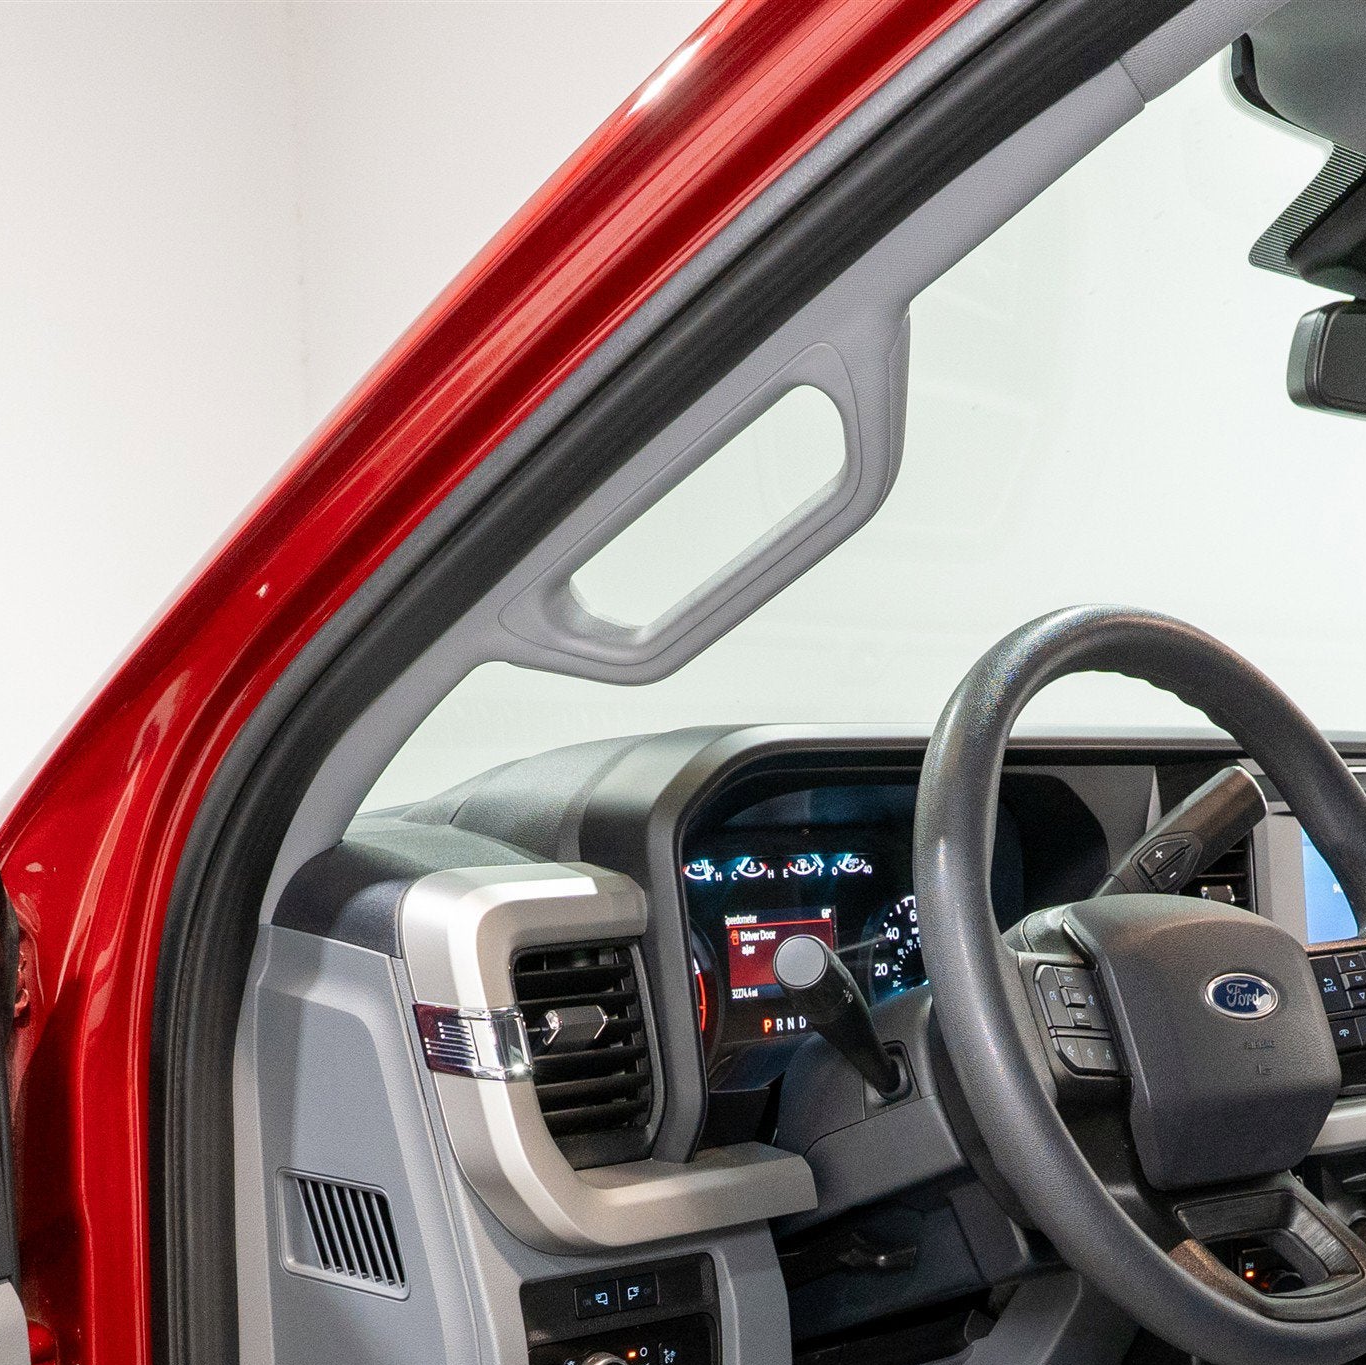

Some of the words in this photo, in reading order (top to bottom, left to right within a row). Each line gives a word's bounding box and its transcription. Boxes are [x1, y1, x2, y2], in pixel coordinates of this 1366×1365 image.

[715, 873, 722, 881] H
[731, 872, 737, 881] C
[768, 870, 775, 879] H
[783, 869, 789, 878] E
[818, 868, 823, 876] F
[909, 909, 917, 922] 6
[740, 930, 760, 942] Driver
[760, 929, 776, 940] Door
[885, 927, 899, 940] 40
[741, 944, 755, 956] ajar
[875, 963, 888, 977] 20
[1225, 982, 1262, 1008] Ford
[1323, 985, 1337, 993] BACK
[763, 1018, 772, 1033] P
[776, 1018, 783, 1031] R
[787, 1016, 795, 1030] N
[799, 1015, 807, 1029] D
